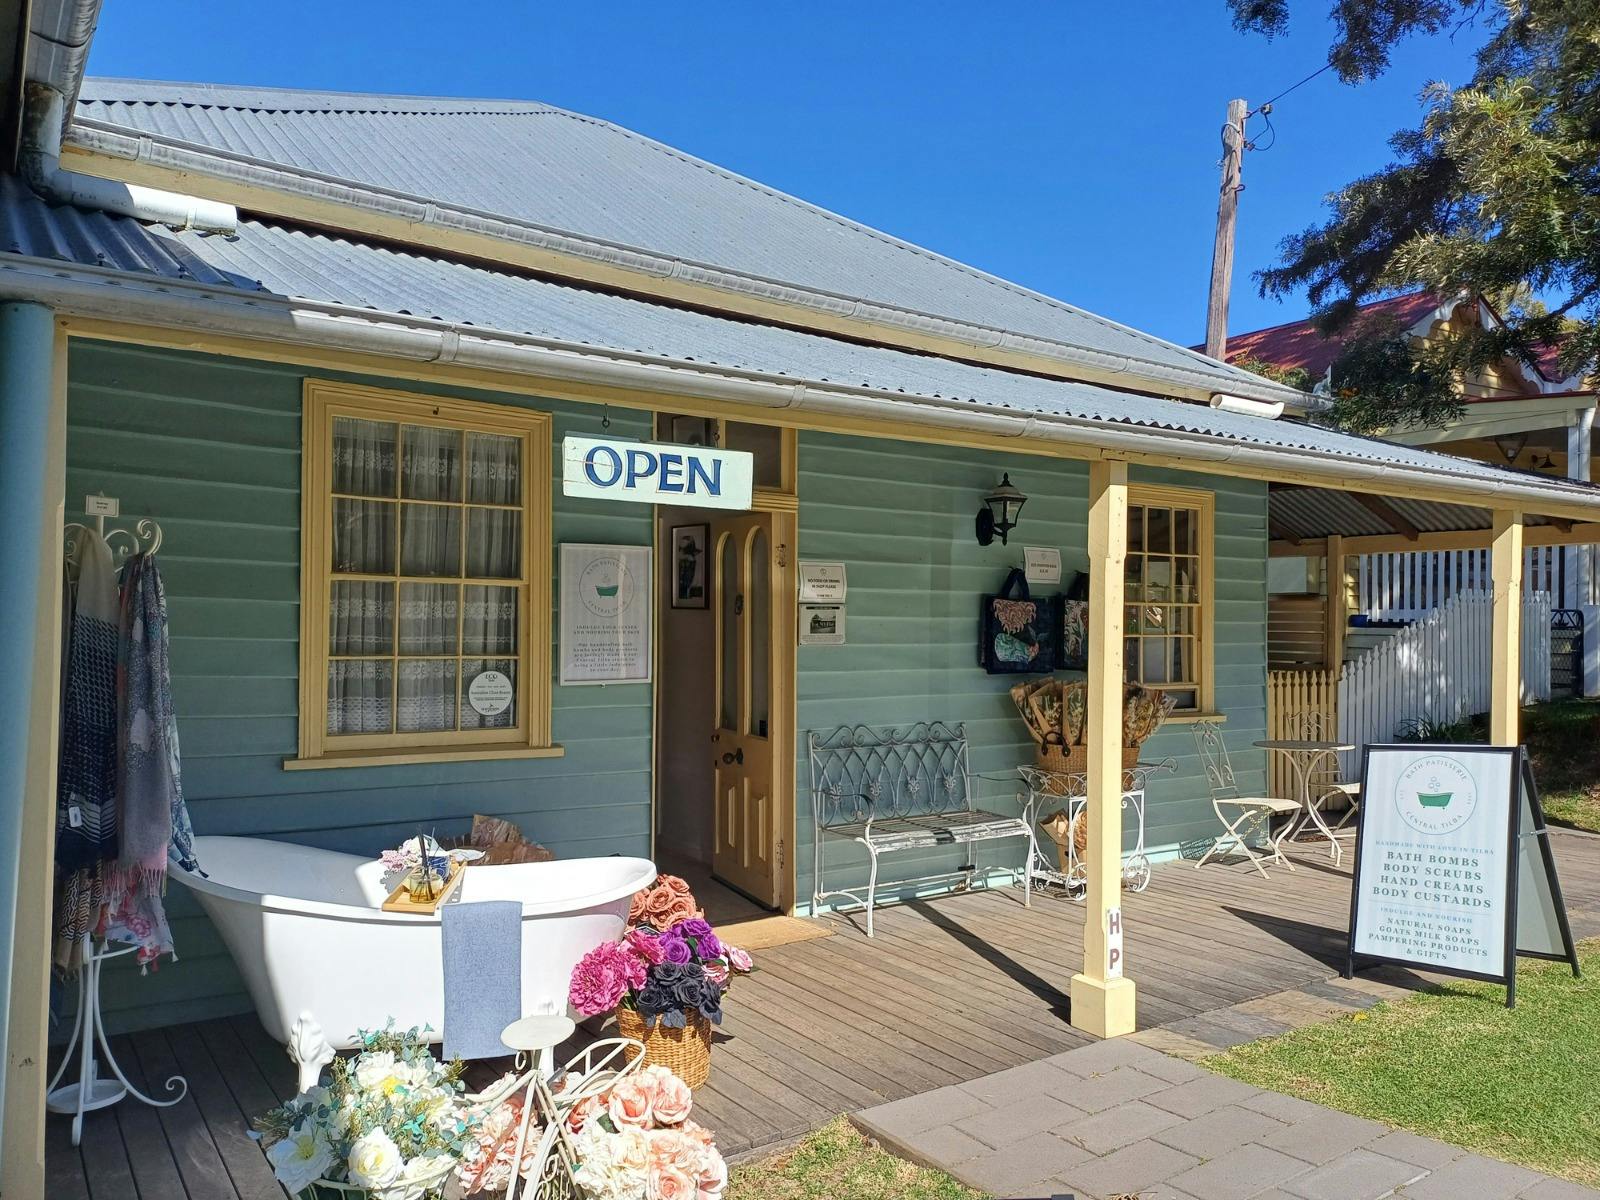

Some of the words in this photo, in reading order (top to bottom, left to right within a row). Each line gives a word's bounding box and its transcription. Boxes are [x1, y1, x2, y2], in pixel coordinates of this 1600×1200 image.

[584, 445, 723, 497] OPEN
[1406, 762, 1424, 779] BATH
[1426, 759, 1467, 780] PATISSERIE
[1406, 810, 1438, 830] CENTRAL
[1441, 815, 1462, 829] TILBA
[1416, 842, 1436, 850] WITH
[1387, 851, 1422, 862] BATH
[1429, 855, 1479, 867] BOMBS
[1383, 863, 1420, 874] BODY
[1424, 867, 1482, 881] SCRUBS
[1380, 875, 1418, 887] HAND
[1424, 880, 1484, 894] CREAMS
[1372, 886, 1409, 898] BODY
[1414, 891, 1492, 908] CUSTARDS
[1416, 911, 1432, 919] AND
[1379, 925, 1411, 936] GOATS
[1414, 931, 1441, 941] MILK
[1445, 935, 1480, 946] SOAPS
[1387, 917, 1434, 931] NATURAL
[1437, 925, 1472, 935] SOAPS
[1368, 933, 1427, 948] PAMPERING
[1431, 942, 1488, 957] PRODUCTS
[1416, 949, 1447, 960] GIFTS
